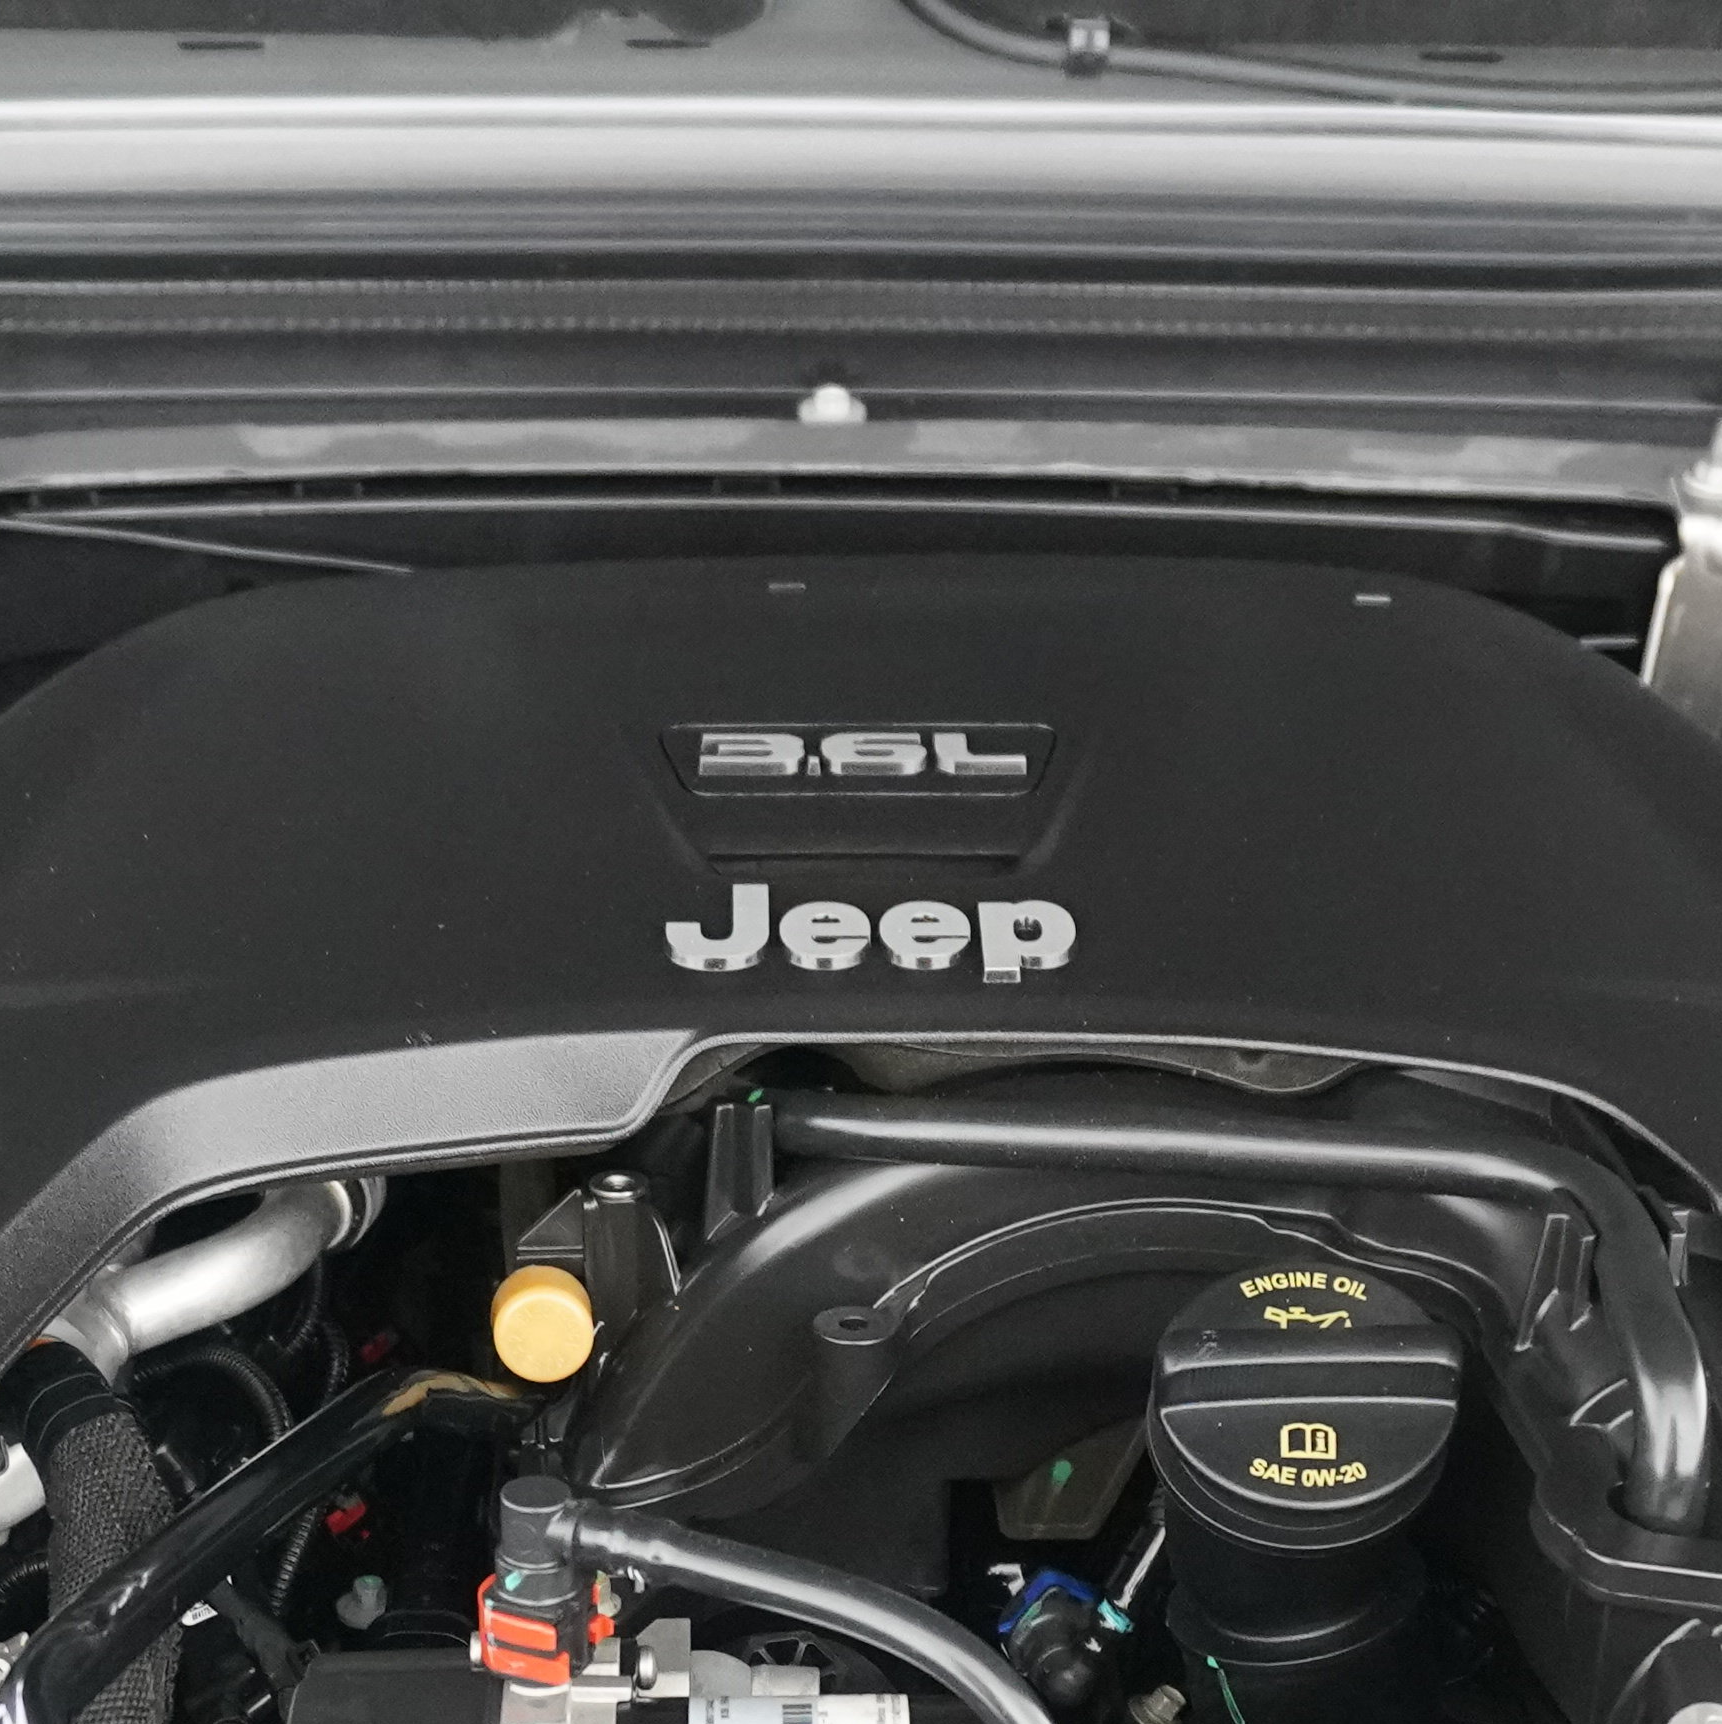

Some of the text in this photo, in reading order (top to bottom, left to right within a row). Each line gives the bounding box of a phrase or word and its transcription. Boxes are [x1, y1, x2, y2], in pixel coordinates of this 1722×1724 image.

[698, 731, 1027, 777] 3.6L
[665, 882, 1077, 984] Jeep
[1238, 1270, 1369, 1303] ENGINE OIL
[1247, 1456, 1368, 1490] SAE 0W-20
